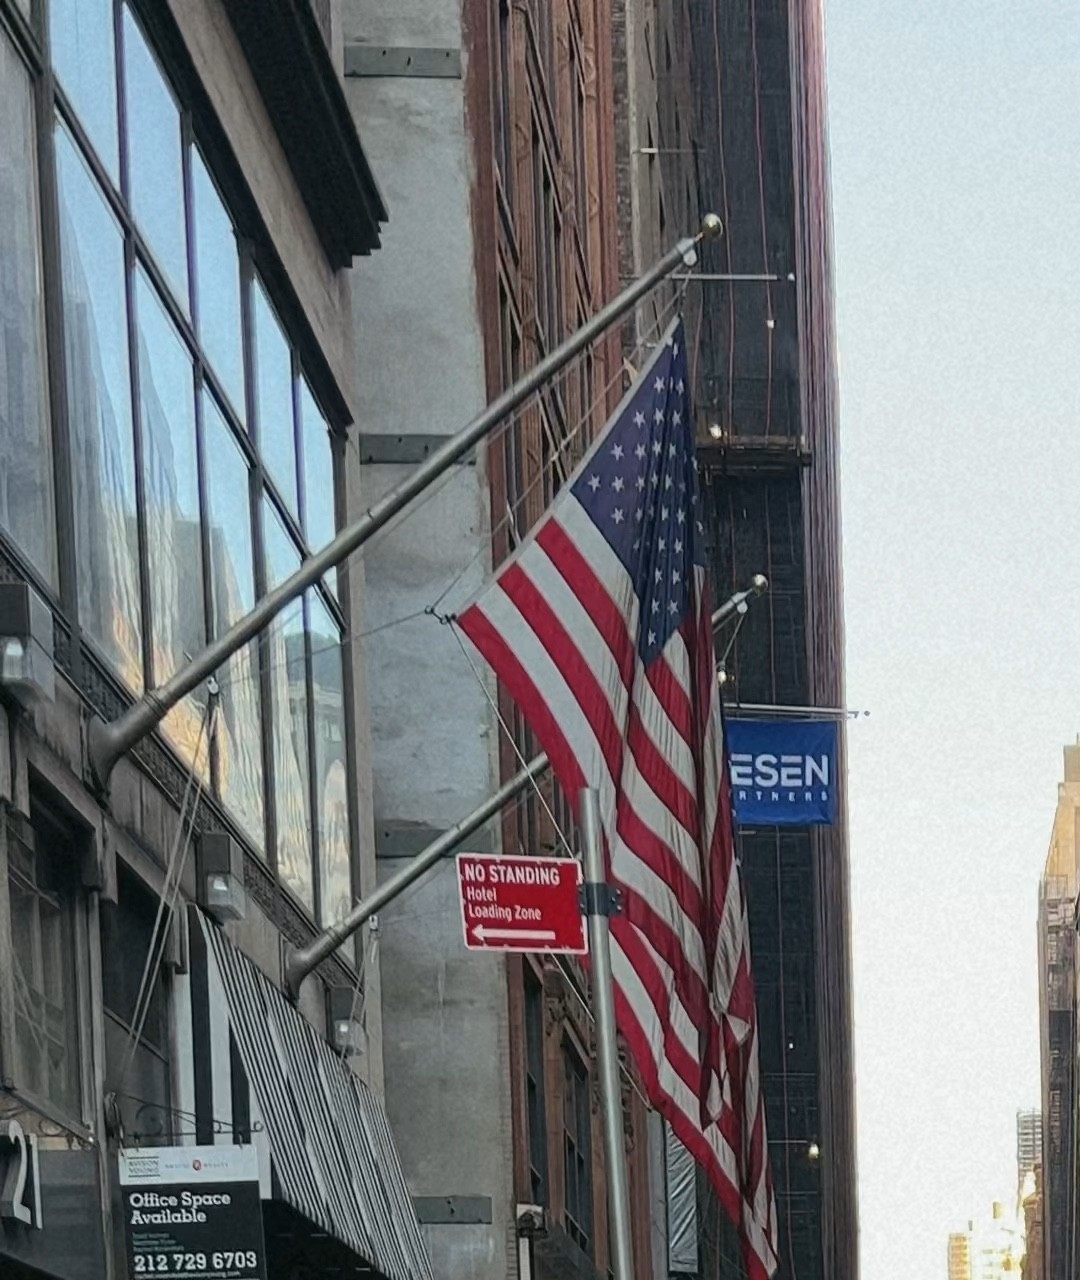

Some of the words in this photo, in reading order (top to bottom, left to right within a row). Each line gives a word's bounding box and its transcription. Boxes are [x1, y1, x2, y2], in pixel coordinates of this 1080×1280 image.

[464, 863, 486, 882] NO
[489, 864, 561, 886] STANDING
[466, 886, 498, 902] Hotel
[468, 903, 513, 922] Loading
[514, 905, 542, 921] Zone
[129, 1192, 178, 1208] Office
[181, 1191, 231, 1209] Space
[130, 1209, 207, 1225] Available
[134, 1254, 169, 1272] 212
[173, 1253, 207, 1271] 729
[212, 1251, 258, 1270] 6703
